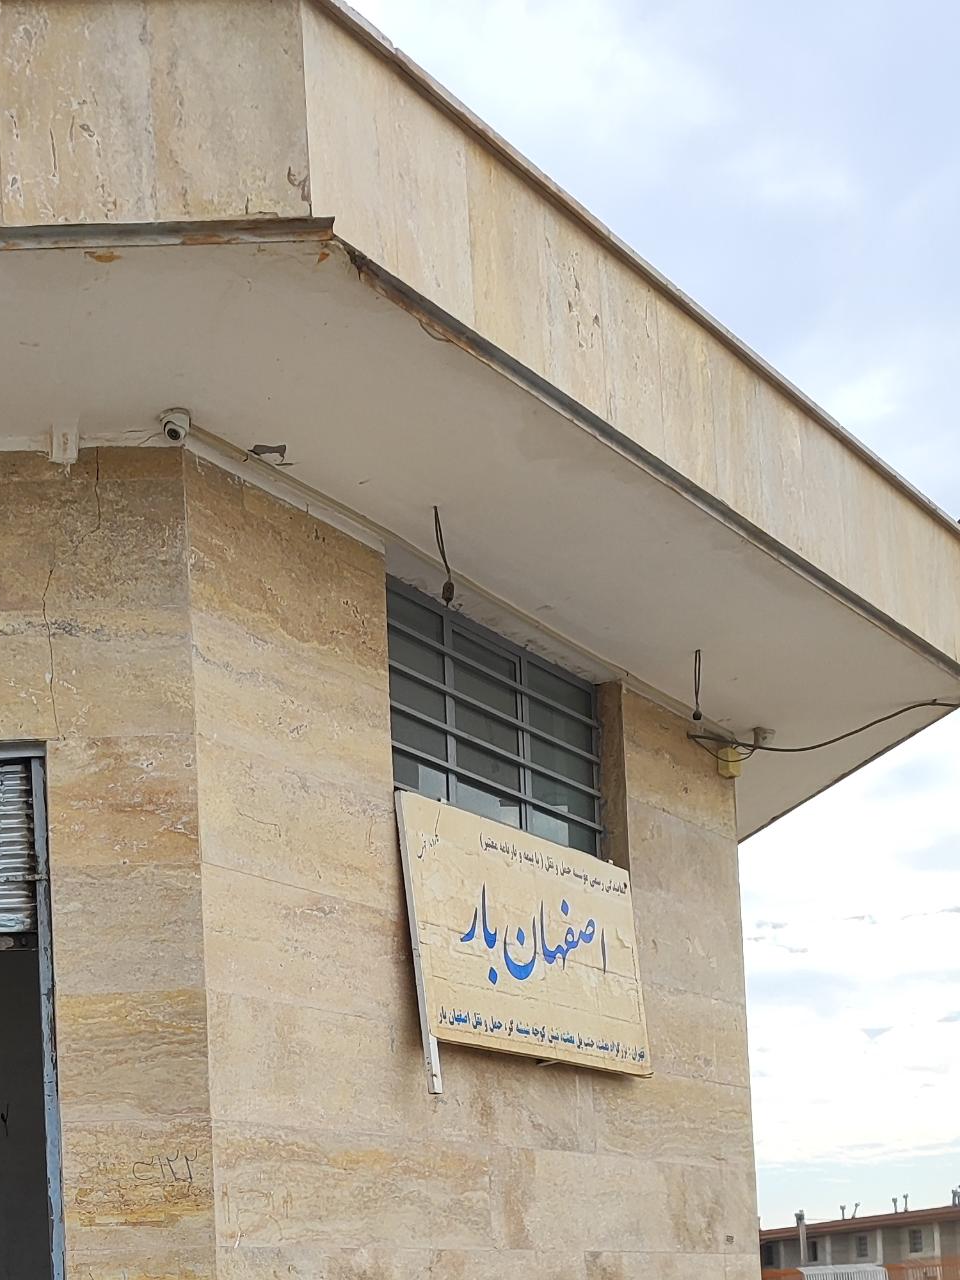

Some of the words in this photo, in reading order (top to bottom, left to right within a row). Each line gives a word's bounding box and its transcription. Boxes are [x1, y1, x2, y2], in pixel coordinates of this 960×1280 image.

[460, 881, 498, 985] بار
[503, 899, 607, 981] اصفهان
[439, 1005, 447, 1024] بار
[449, 1008, 470, 1026] اصفهان
[472, 1012, 482, 1029] نقل
[489, 1016, 502, 1032] حمل
